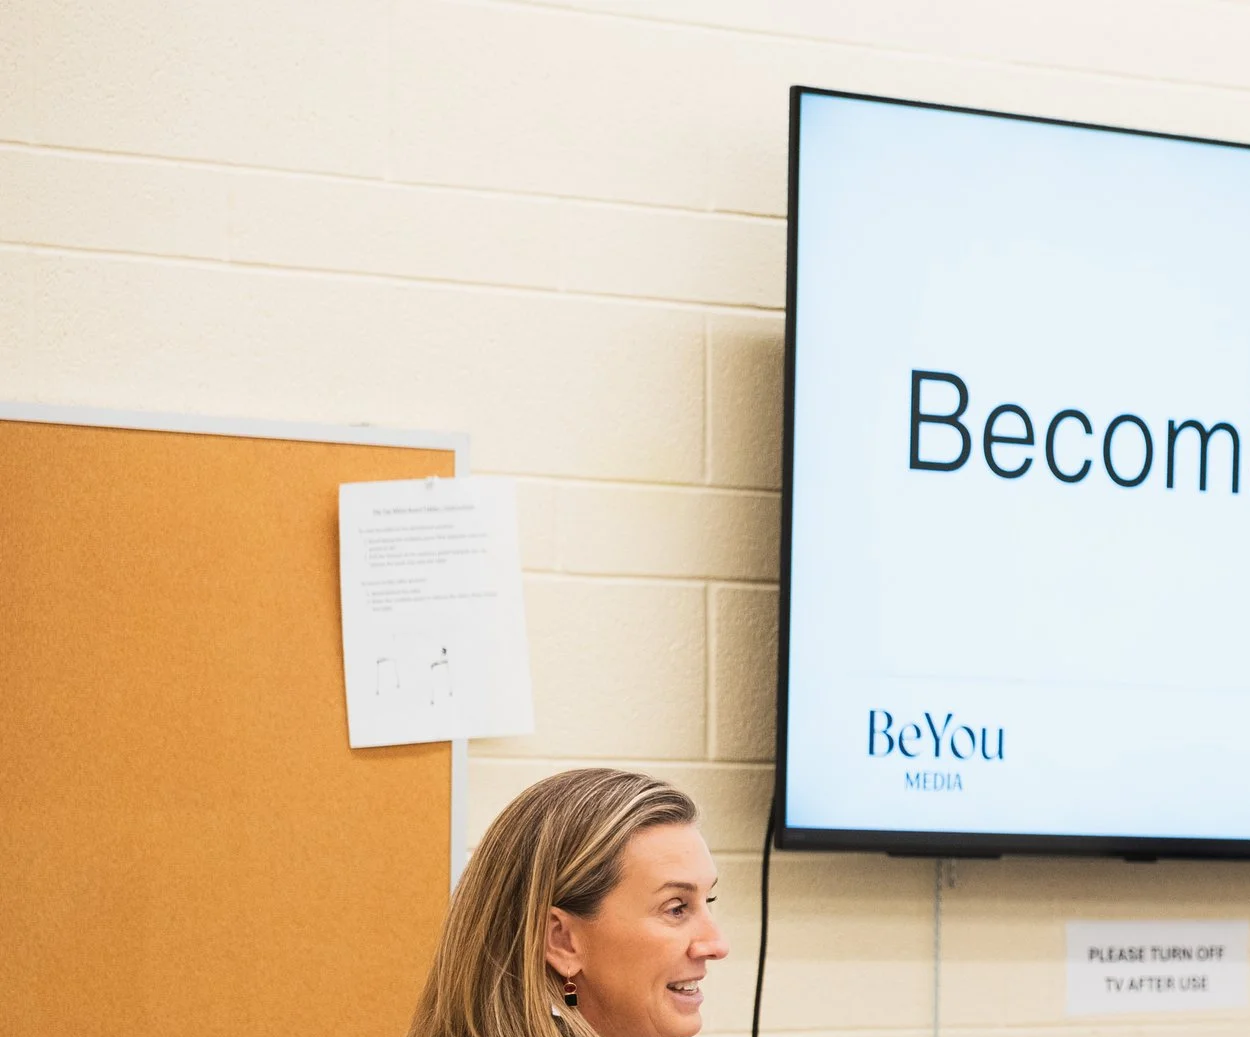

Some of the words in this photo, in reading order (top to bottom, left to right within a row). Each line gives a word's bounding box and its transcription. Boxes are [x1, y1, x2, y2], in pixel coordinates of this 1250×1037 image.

[868, 710, 1003, 760] BeYou
[905, 771, 963, 791] MEDIA
[1088, 945, 1145, 962] PLEASE
[1150, 945, 1193, 962] TURN
[1197, 944, 1225, 961] OFF
[1104, 976, 1125, 992] TV
[1128, 975, 1176, 992] AFTER
[1180, 975, 1209, 992] USE
